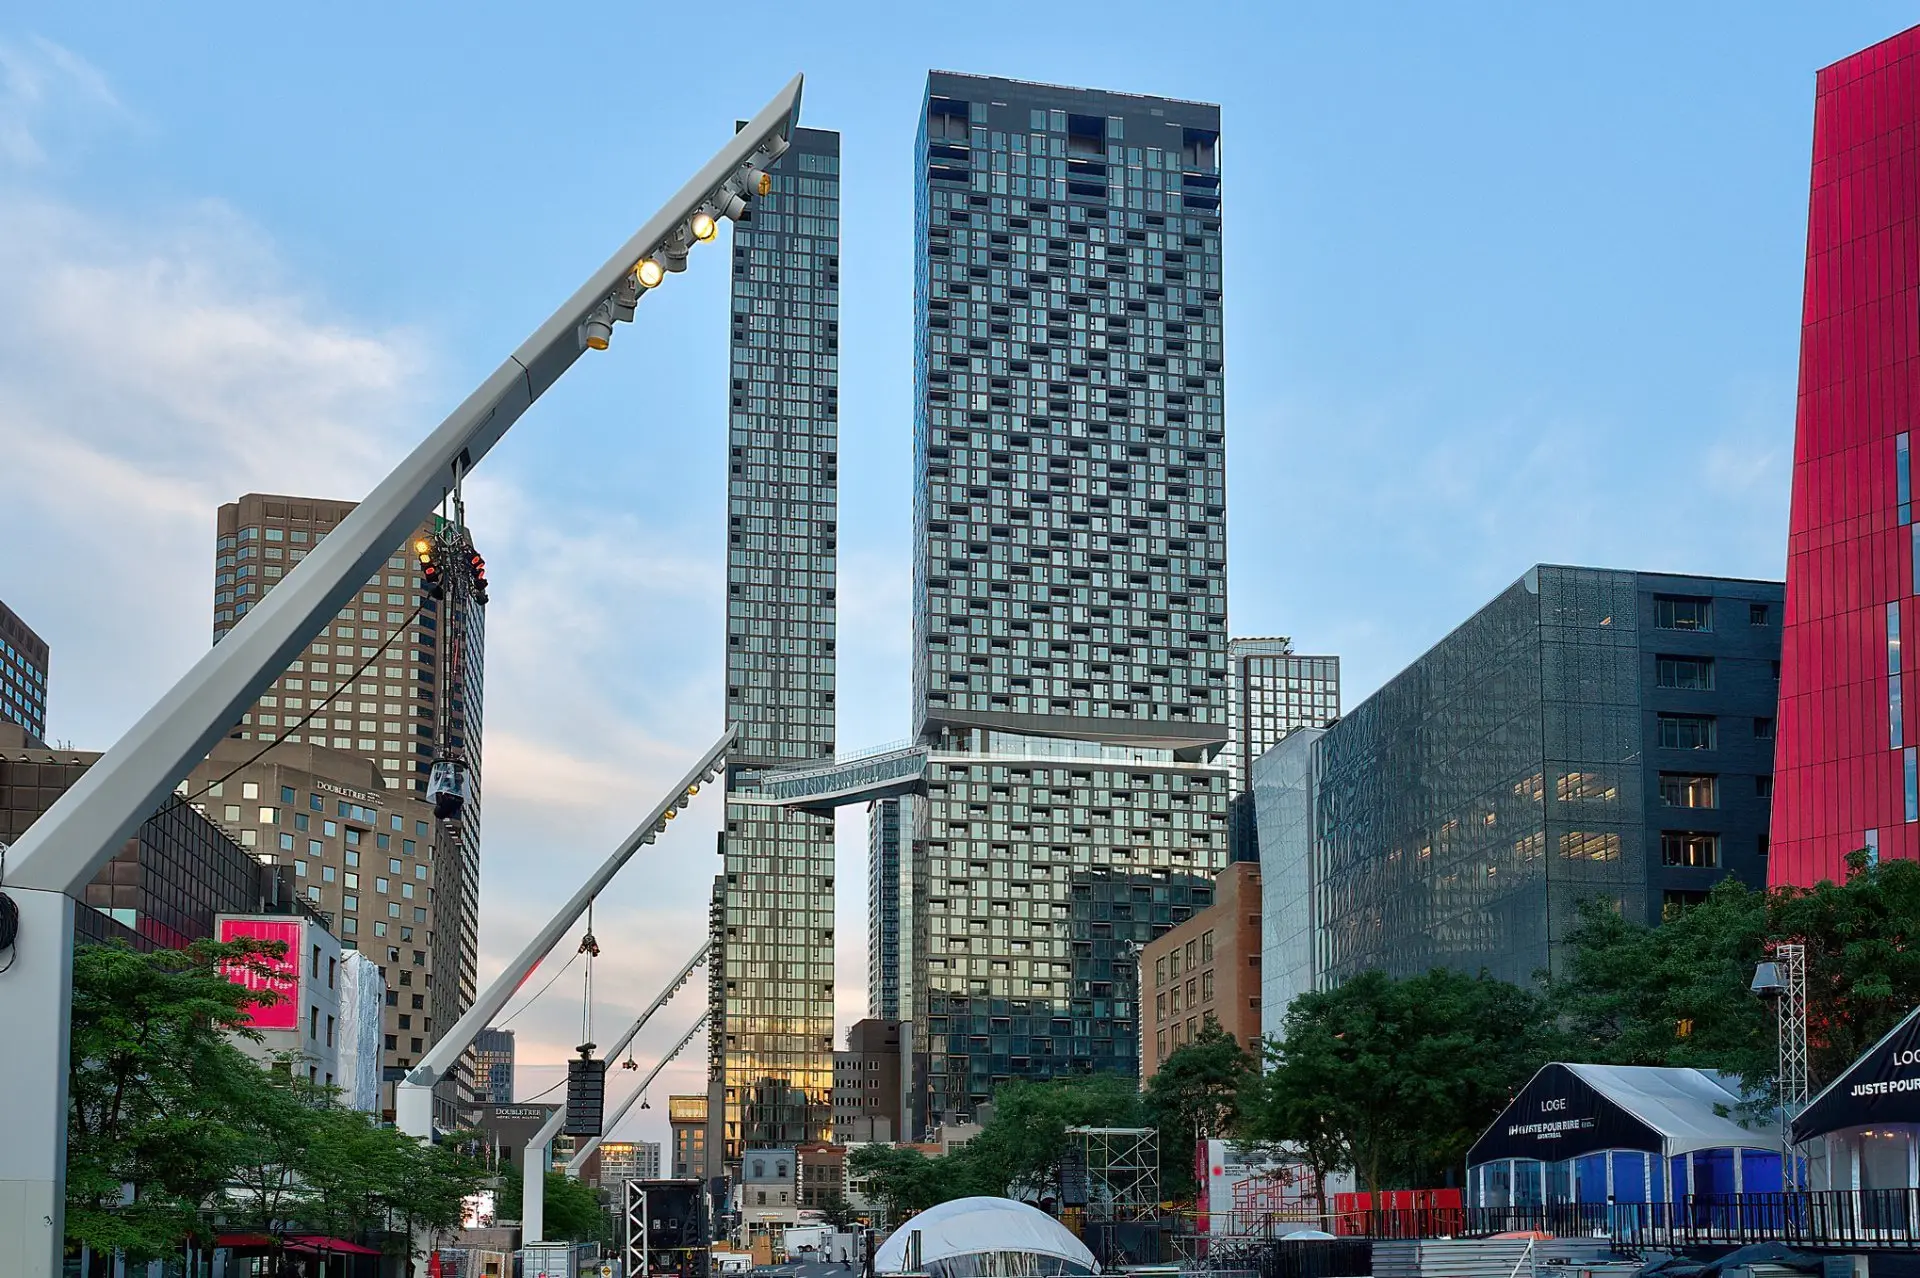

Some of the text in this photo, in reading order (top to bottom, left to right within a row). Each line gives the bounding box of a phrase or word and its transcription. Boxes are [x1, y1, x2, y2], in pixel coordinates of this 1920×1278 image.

[1851, 1078, 1920, 1096] JUSTE POUR
[1541, 1098, 1566, 1112] LOGE
